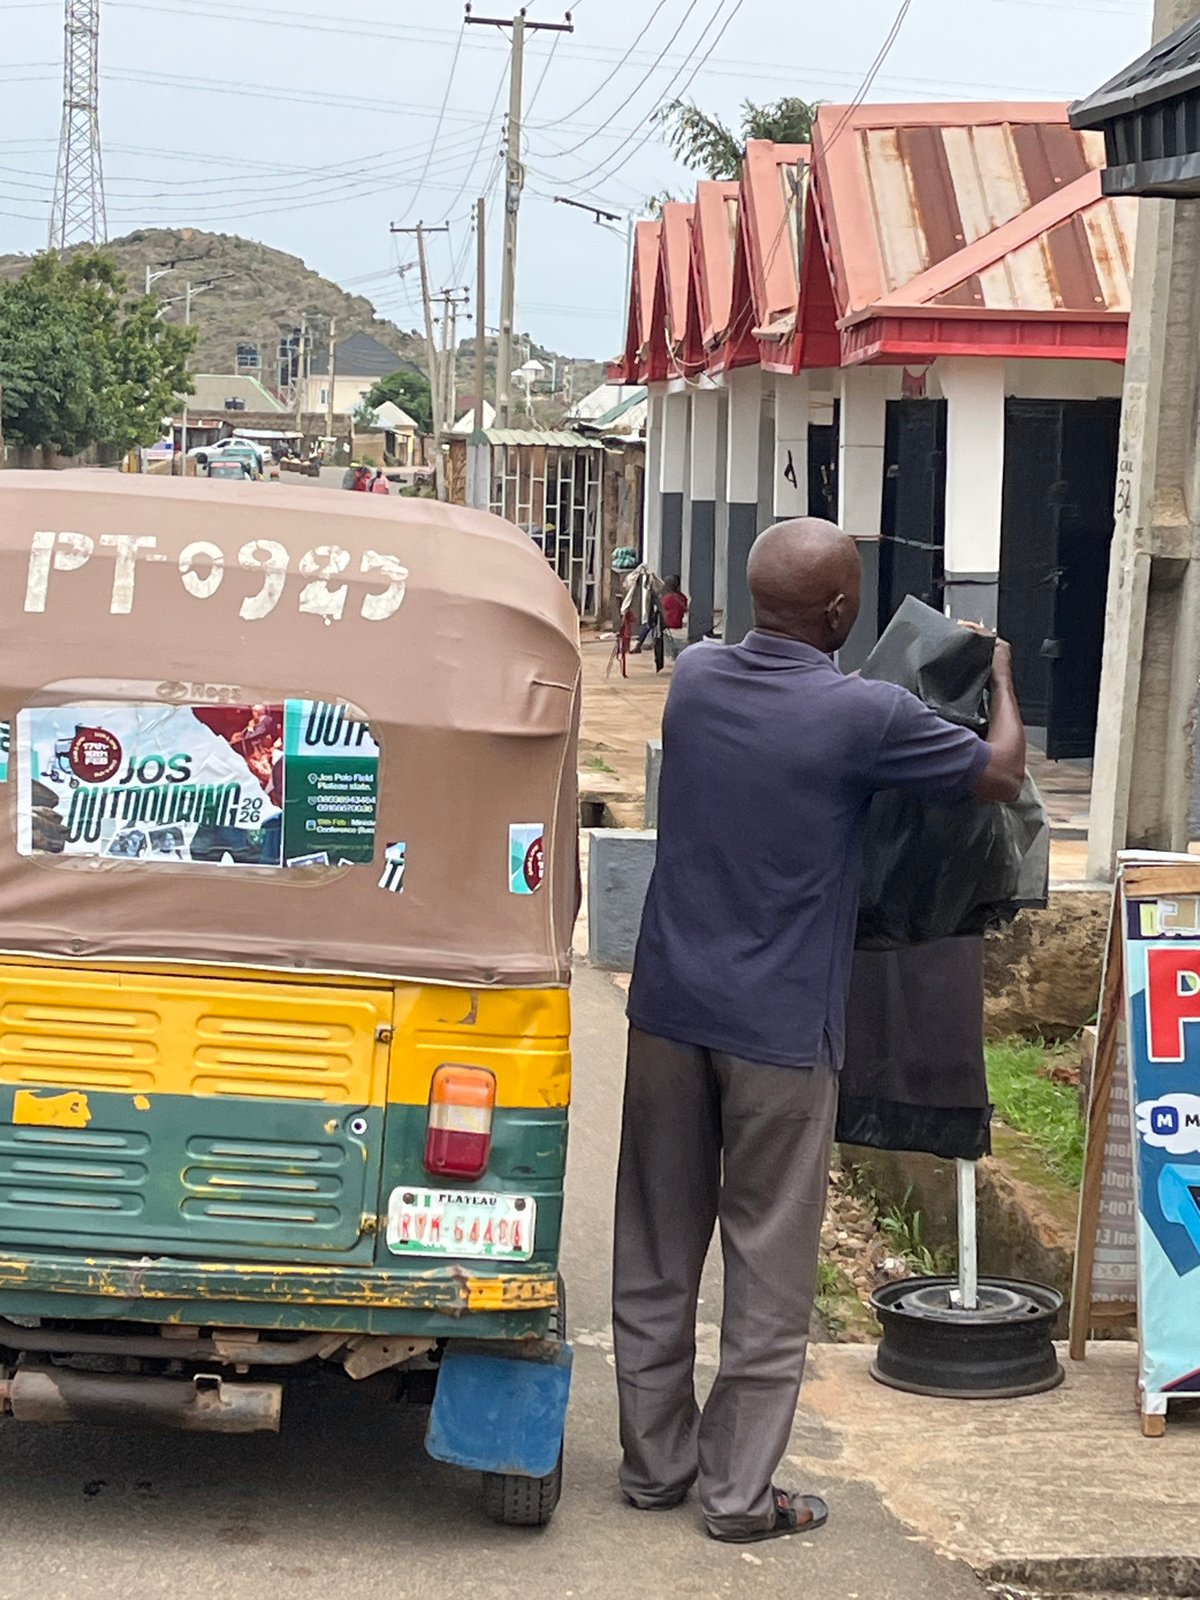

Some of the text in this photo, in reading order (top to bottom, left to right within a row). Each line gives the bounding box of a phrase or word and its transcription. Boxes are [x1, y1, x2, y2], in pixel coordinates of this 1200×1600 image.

[119, 753, 193, 785] JOS
[241, 797, 263, 811] 20
[238, 810, 261, 823] 26
[1185, 1113, 1200, 1128] M
[438, 1193, 498, 1207] PLATEAU
